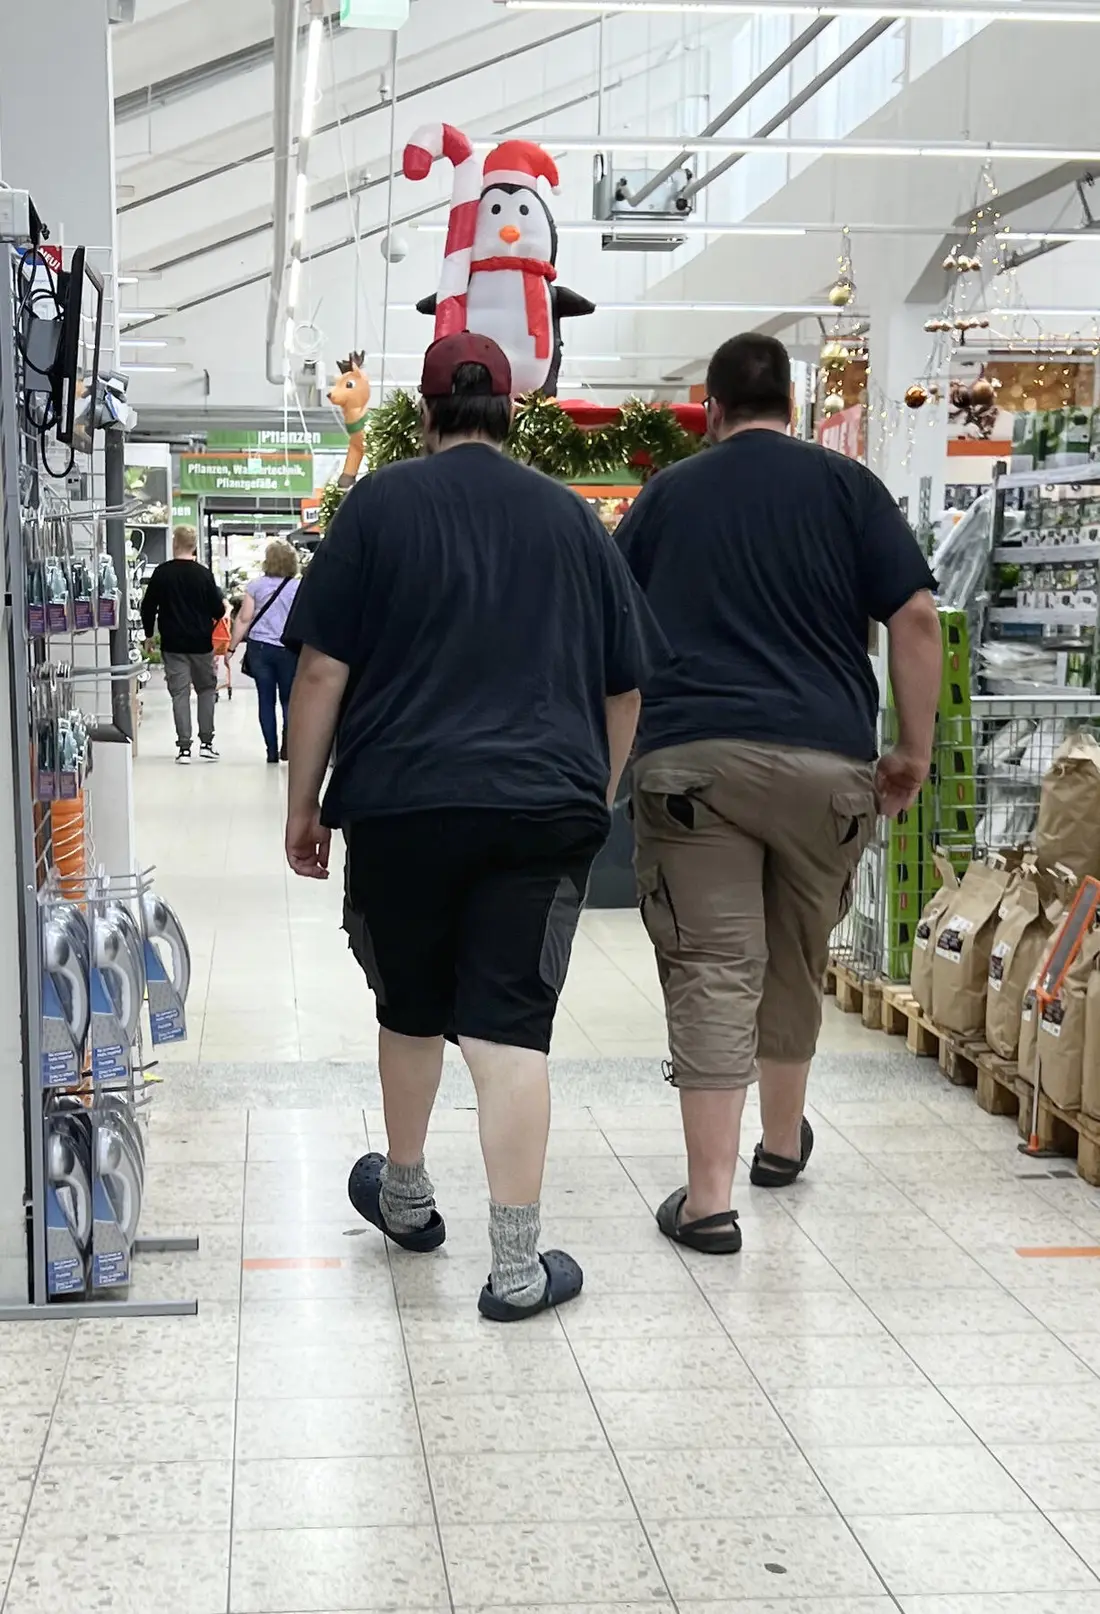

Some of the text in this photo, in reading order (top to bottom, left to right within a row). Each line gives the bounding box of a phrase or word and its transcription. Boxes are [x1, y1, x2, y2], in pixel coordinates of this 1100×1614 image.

[261, 430, 321, 444] Pflanzen
[188, 463, 232, 476] Pflanzen,
[216, 478, 278, 490] Pflanzgefäße
